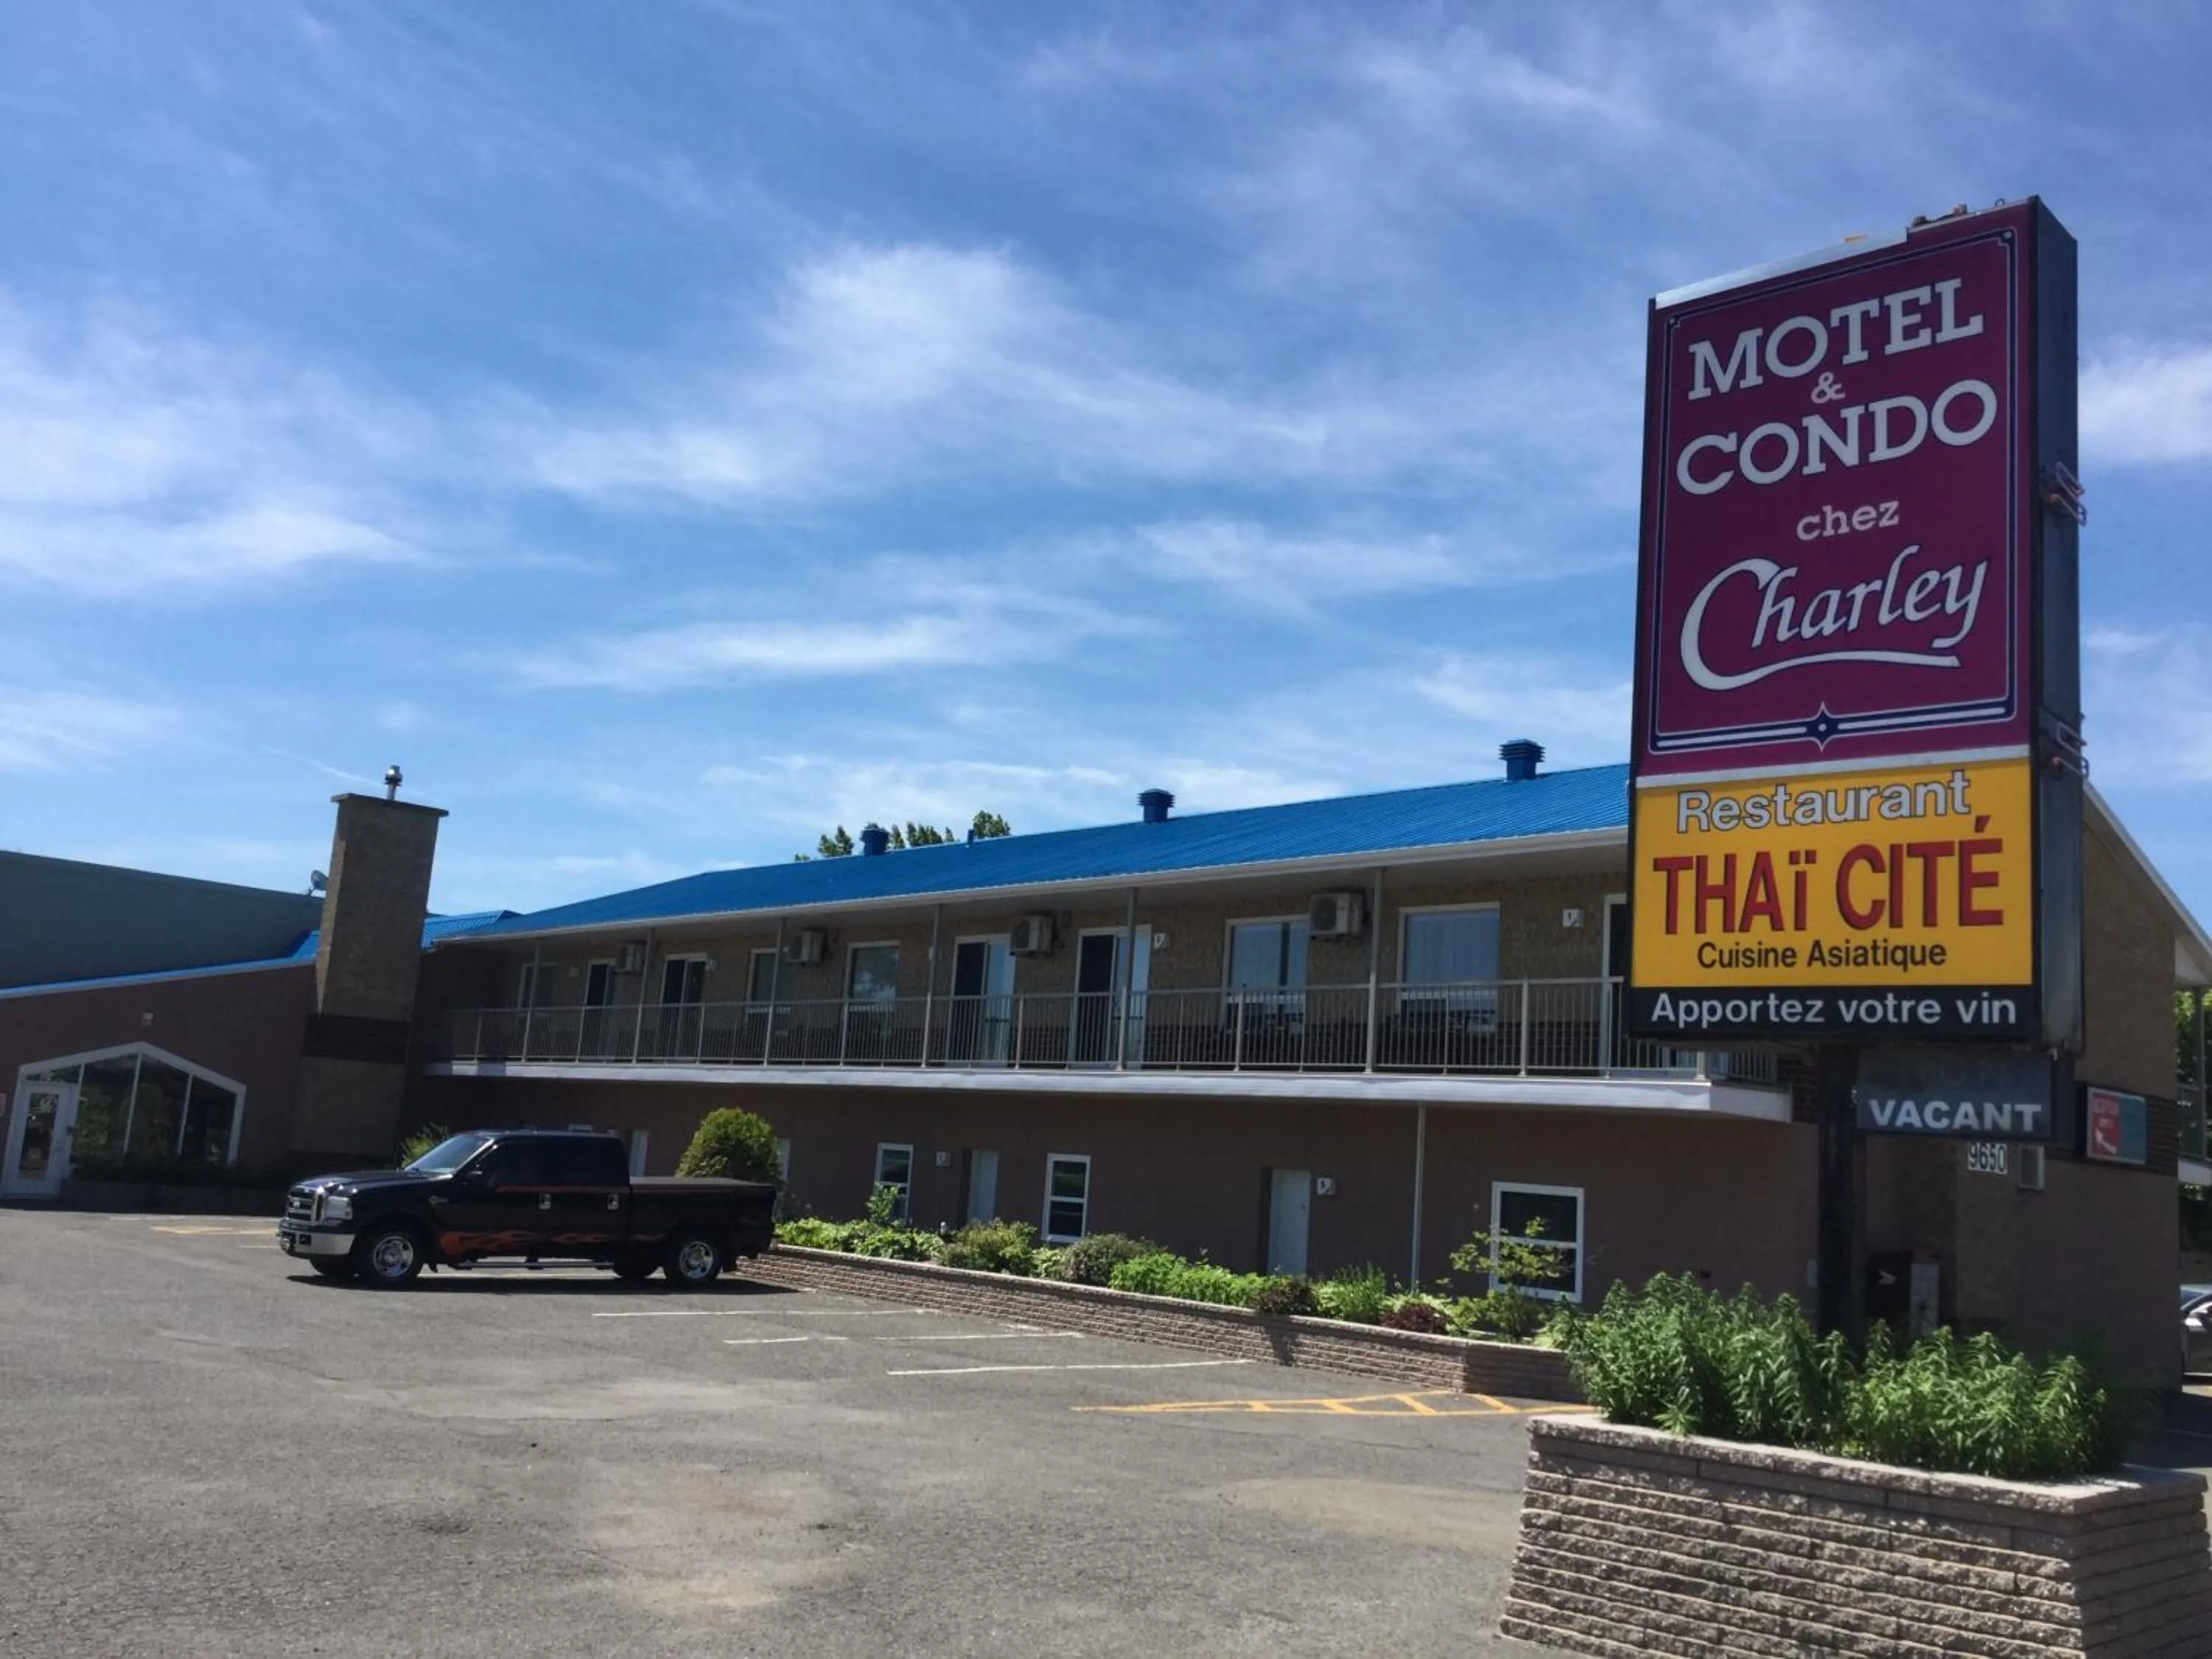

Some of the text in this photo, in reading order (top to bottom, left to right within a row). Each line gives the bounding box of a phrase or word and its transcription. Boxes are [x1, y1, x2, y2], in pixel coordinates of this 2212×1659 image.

[1688, 278, 1983, 400] MOTEL
[1811, 372, 1846, 404] &
[1676, 380, 1997, 495] CONDO
[1796, 500, 1900, 540] chez
[1680, 545, 1988, 690] Charley
[1677, 769, 1971, 833] Restaurant
[1835, 815, 2004, 931] CITÉ
[1697, 938, 1947, 973] Cuisine Asiatique
[1651, 992, 2017, 1029] Apportez votre vin
[1869, 1099, 2042, 1133] VACANT
[1969, 1141, 2006, 1172] 9650
